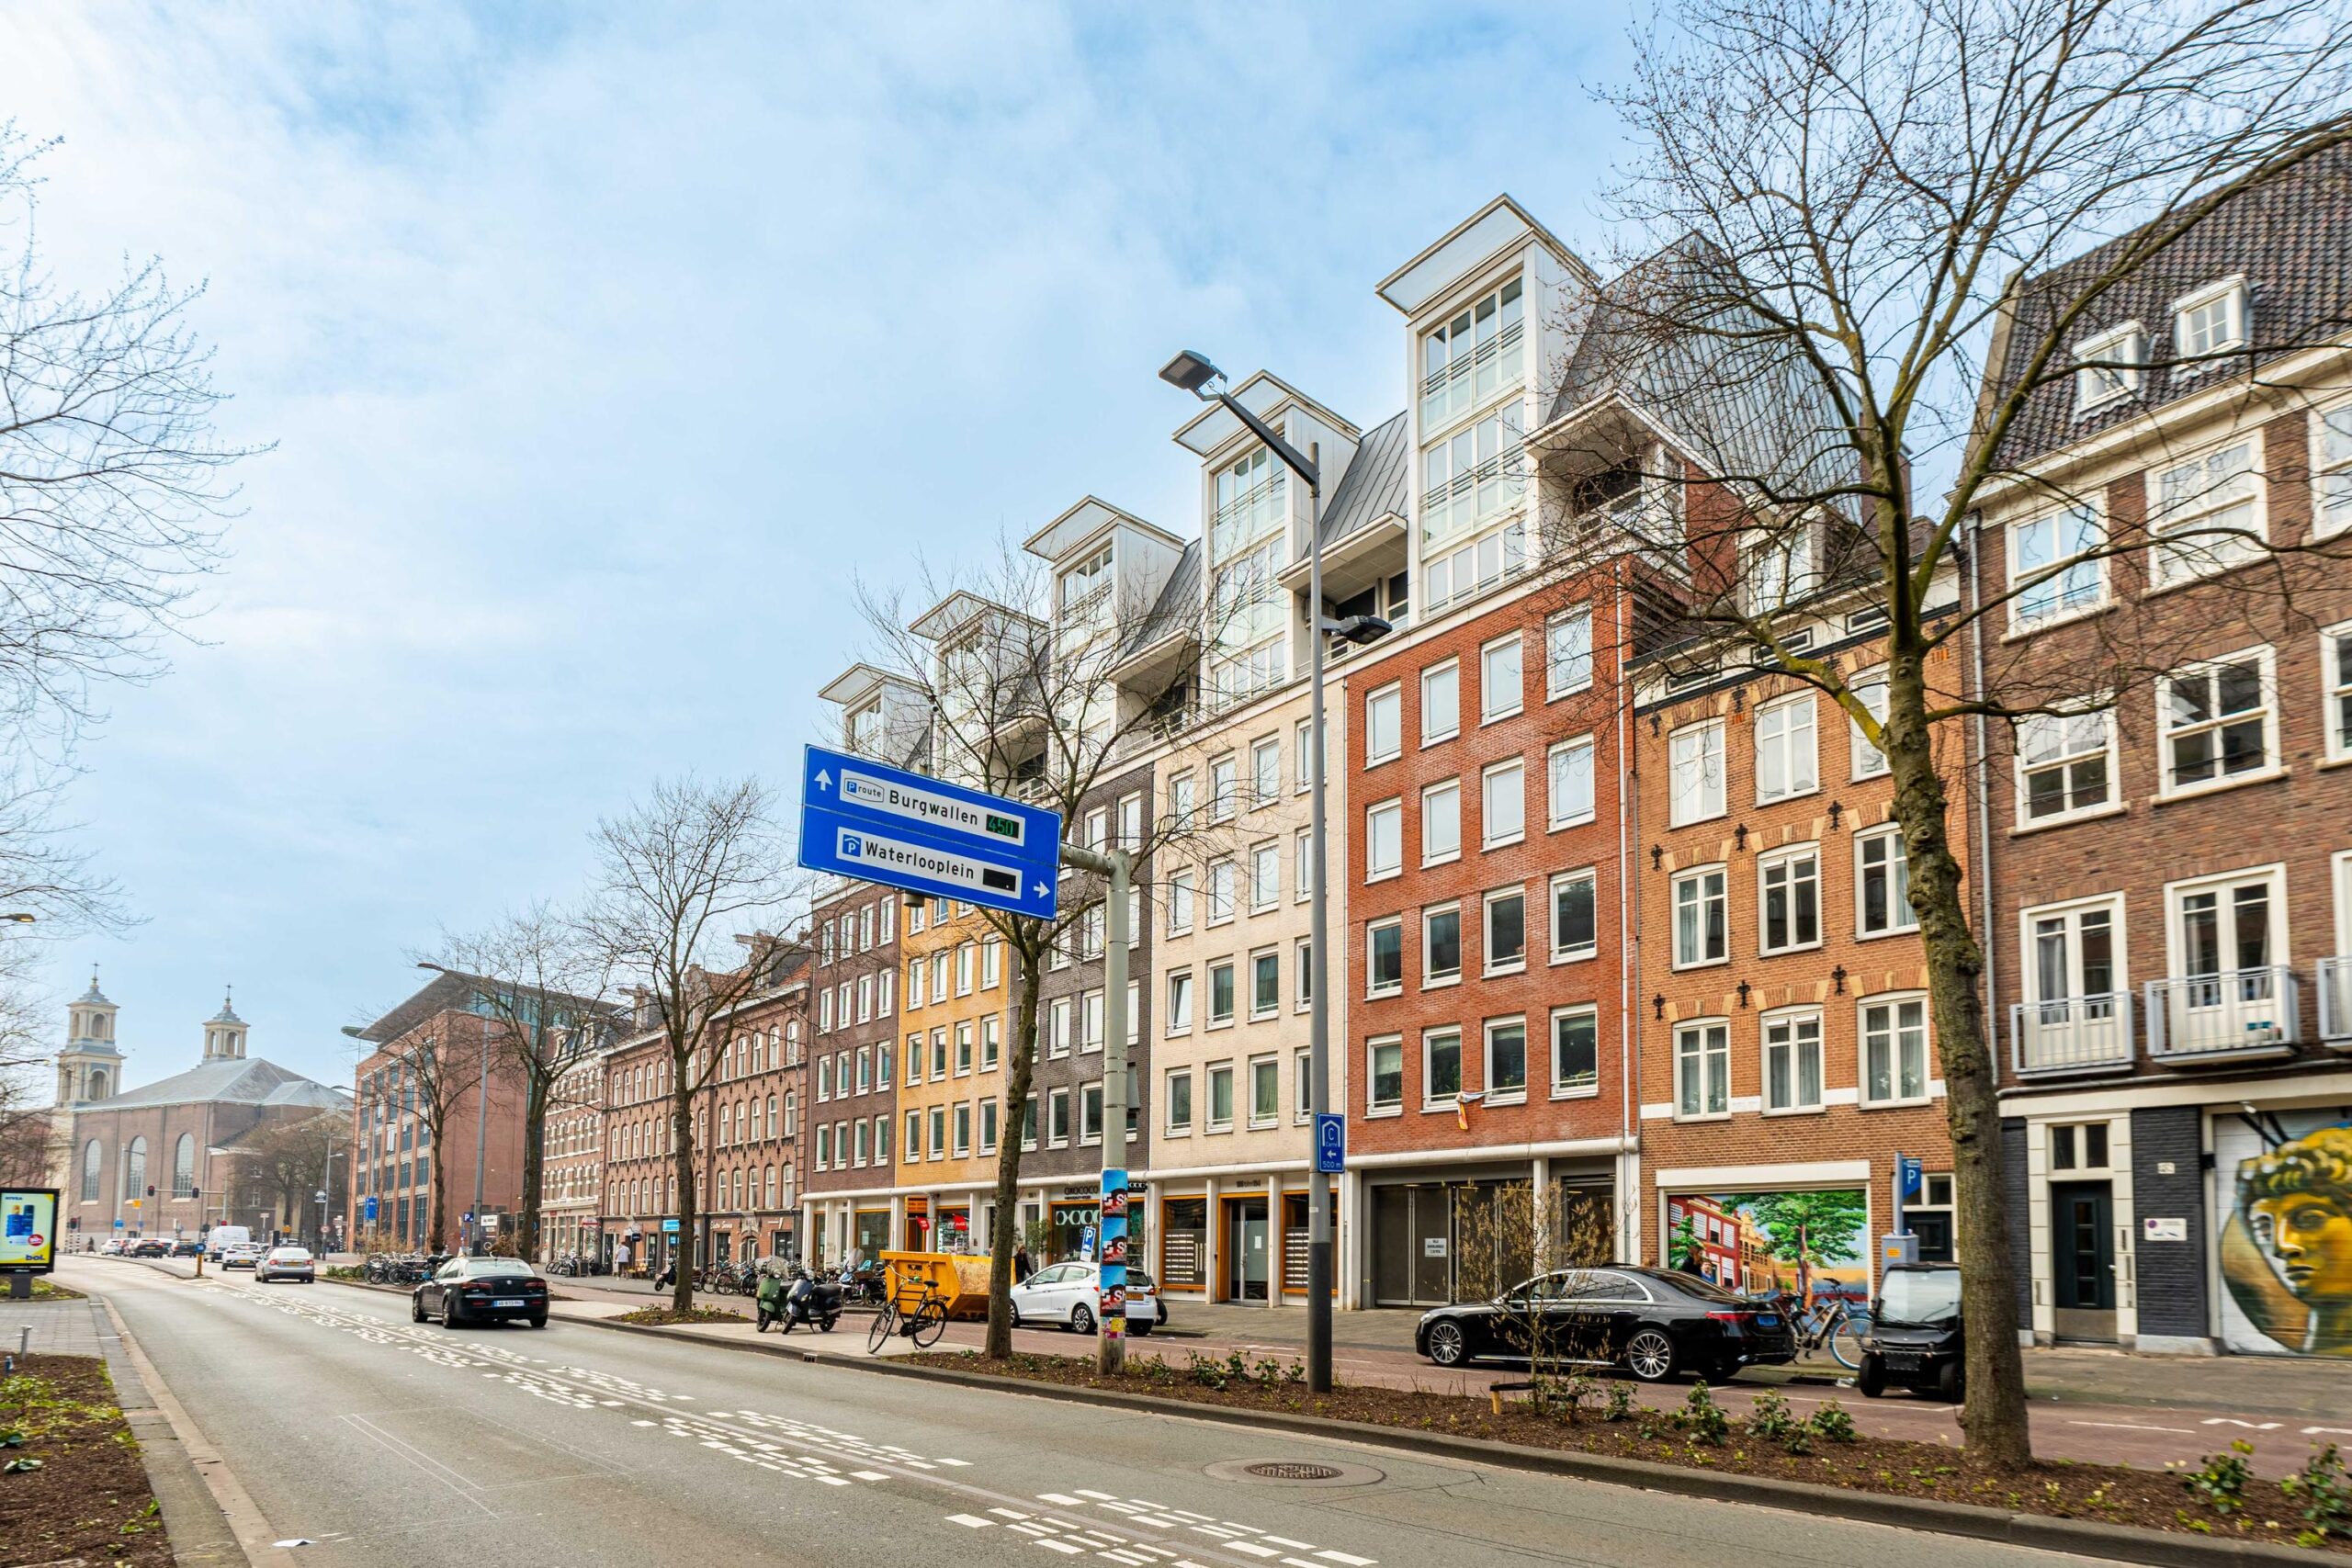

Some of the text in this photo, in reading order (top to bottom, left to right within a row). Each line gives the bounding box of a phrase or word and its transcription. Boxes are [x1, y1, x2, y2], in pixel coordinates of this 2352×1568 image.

[848, 782, 1013, 836] P route Burgwallen 450
[848, 841, 974, 879] P Waterlooplein
[1329, 1128, 1334, 1141] C
[1907, 1169, 1917, 1185] P
[464, 1213, 470, 1222] P
[1085, 1229, 1093, 1242] P
